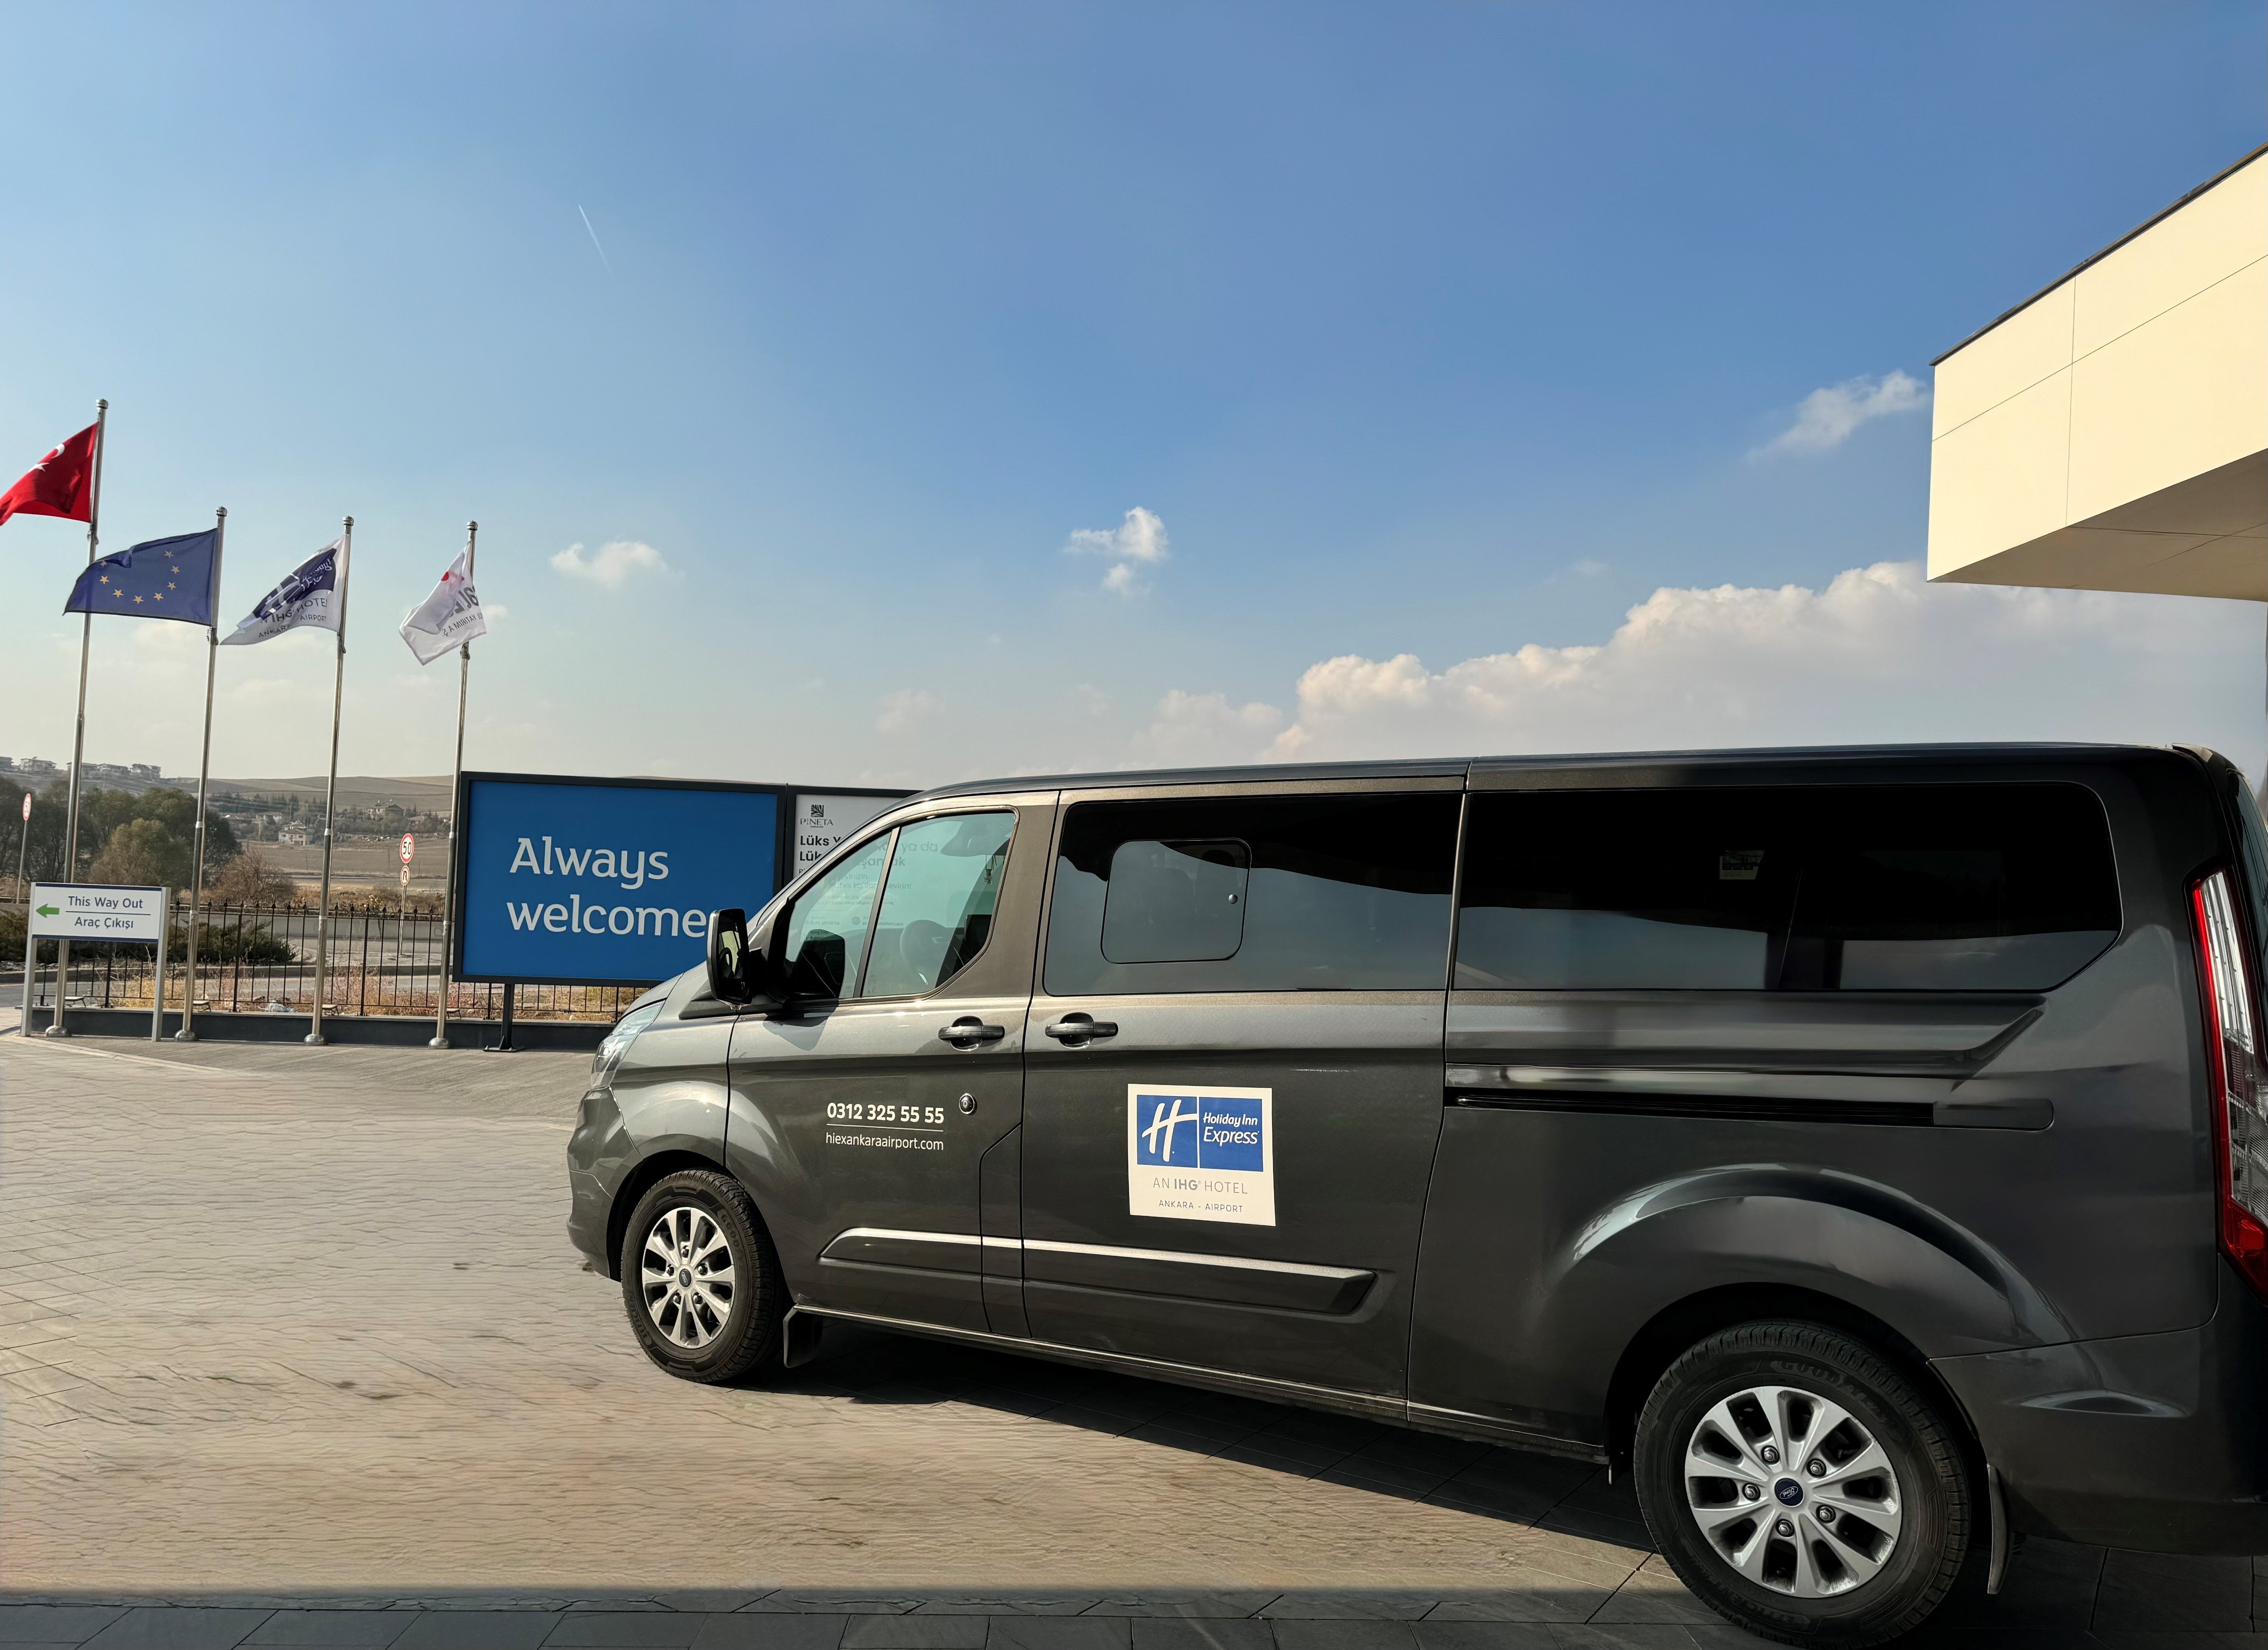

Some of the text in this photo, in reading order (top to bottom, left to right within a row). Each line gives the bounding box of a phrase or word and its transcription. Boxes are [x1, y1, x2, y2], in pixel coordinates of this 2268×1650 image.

[800, 835, 829, 846] Lüks
[403, 842, 412, 855] 50
[800, 851, 822, 861] Lük
[509, 836, 669, 889] Always
[68, 896, 143, 909] This Way Out
[74, 916, 133, 929] Araç Çıkışı
[507, 894, 707, 937] welcome
[827, 1103, 944, 1124] 0312 325 55 55
[1203, 1112, 1258, 1127] Holiday Inn
[825, 1132, 944, 1151] hiexankaraairport.com
[1203, 1126, 1258, 1147] Express
[1153, 1177, 1170, 1189] AN
[1205, 1181, 1248, 1194] HOTEL
[1159, 1200, 1194, 1209] ANKARA
[1205, 1203, 1243, 1213] AIRPORT
